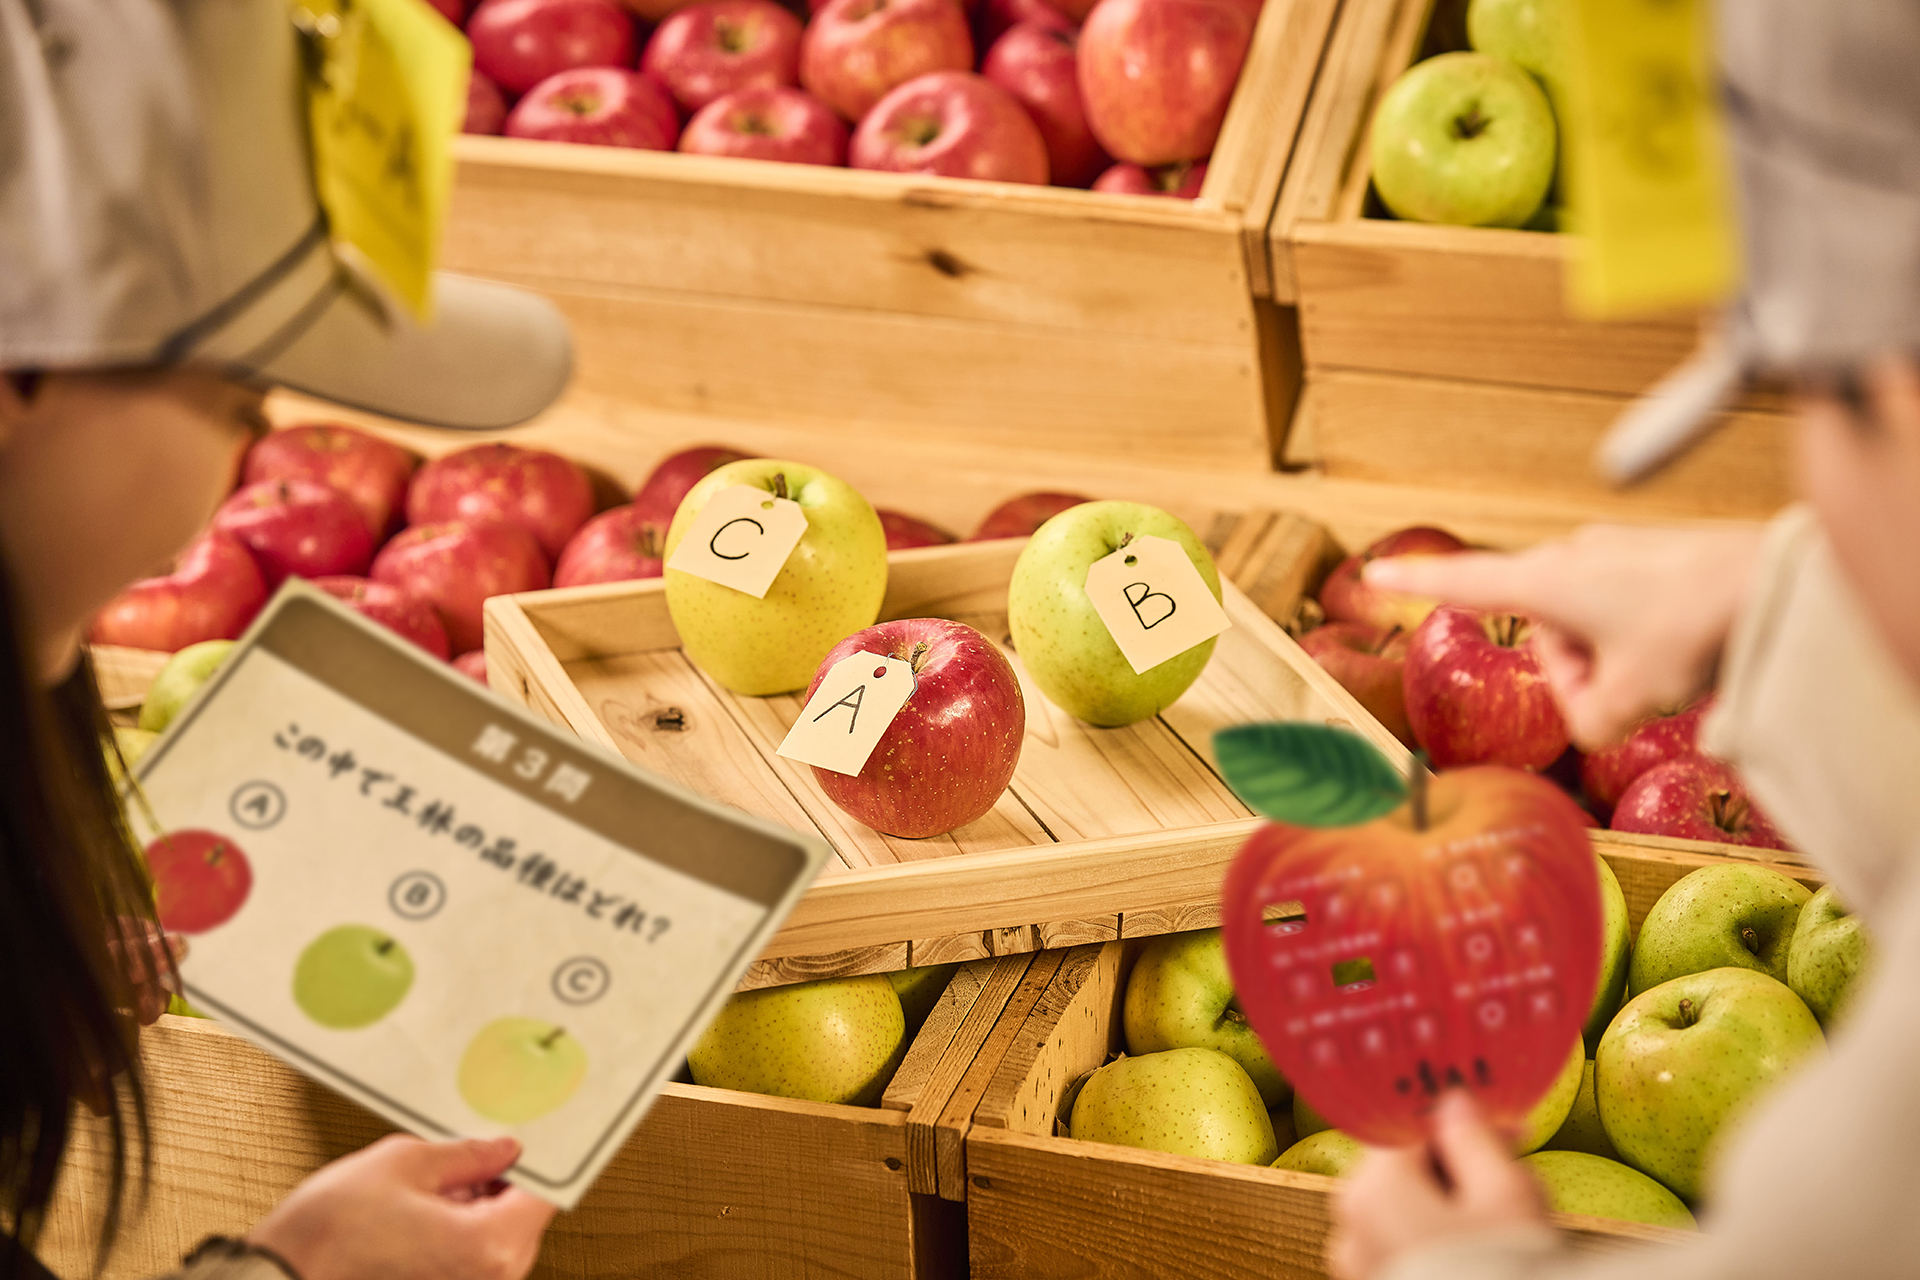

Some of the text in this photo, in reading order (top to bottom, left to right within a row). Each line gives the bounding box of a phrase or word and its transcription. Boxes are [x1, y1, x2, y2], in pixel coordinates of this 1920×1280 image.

[709, 517, 764, 561] C
[1122, 582, 1177, 630] B
[812, 684, 866, 734] A
